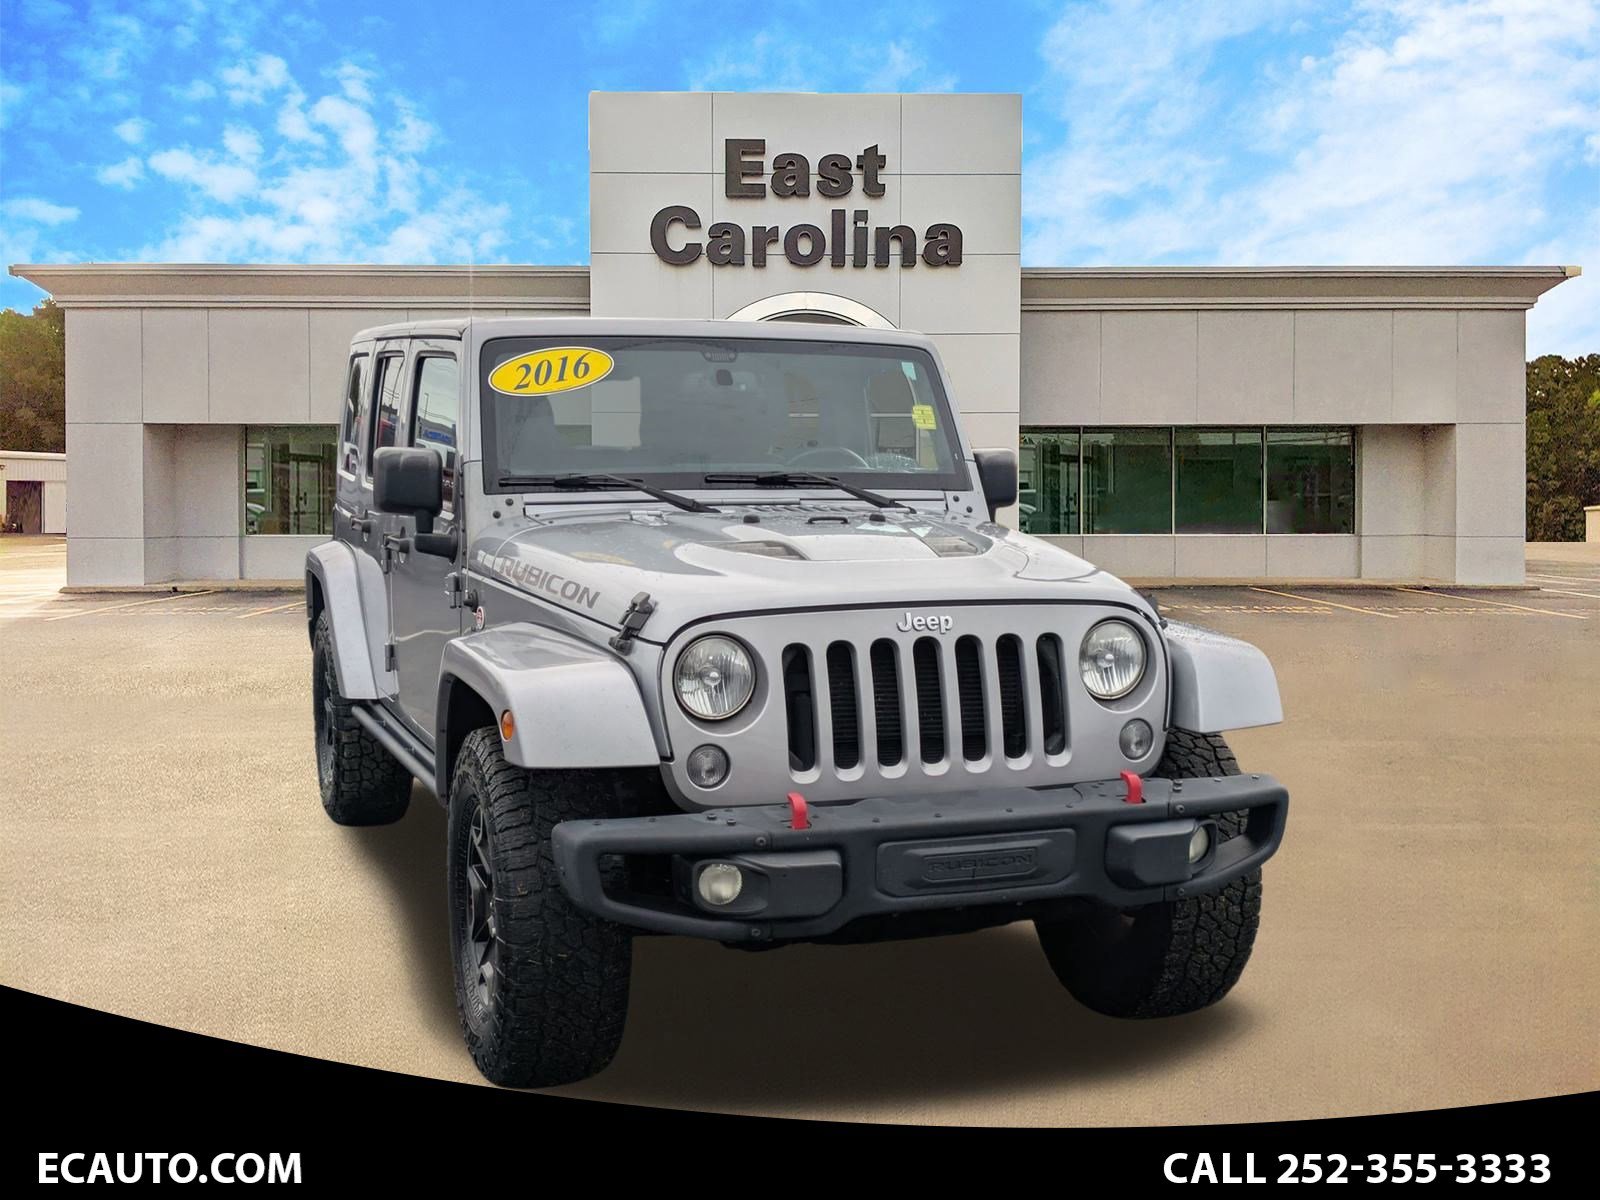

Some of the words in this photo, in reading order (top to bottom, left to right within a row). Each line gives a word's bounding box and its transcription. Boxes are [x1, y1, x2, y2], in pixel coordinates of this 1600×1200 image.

[724, 138, 886, 198] East
[650, 205, 963, 268] Carolina
[514, 352, 590, 391] 2016
[499, 556, 600, 609] RUBICON
[897, 612, 953, 634] Jeep
[927, 854, 1033, 873] RUBICON
